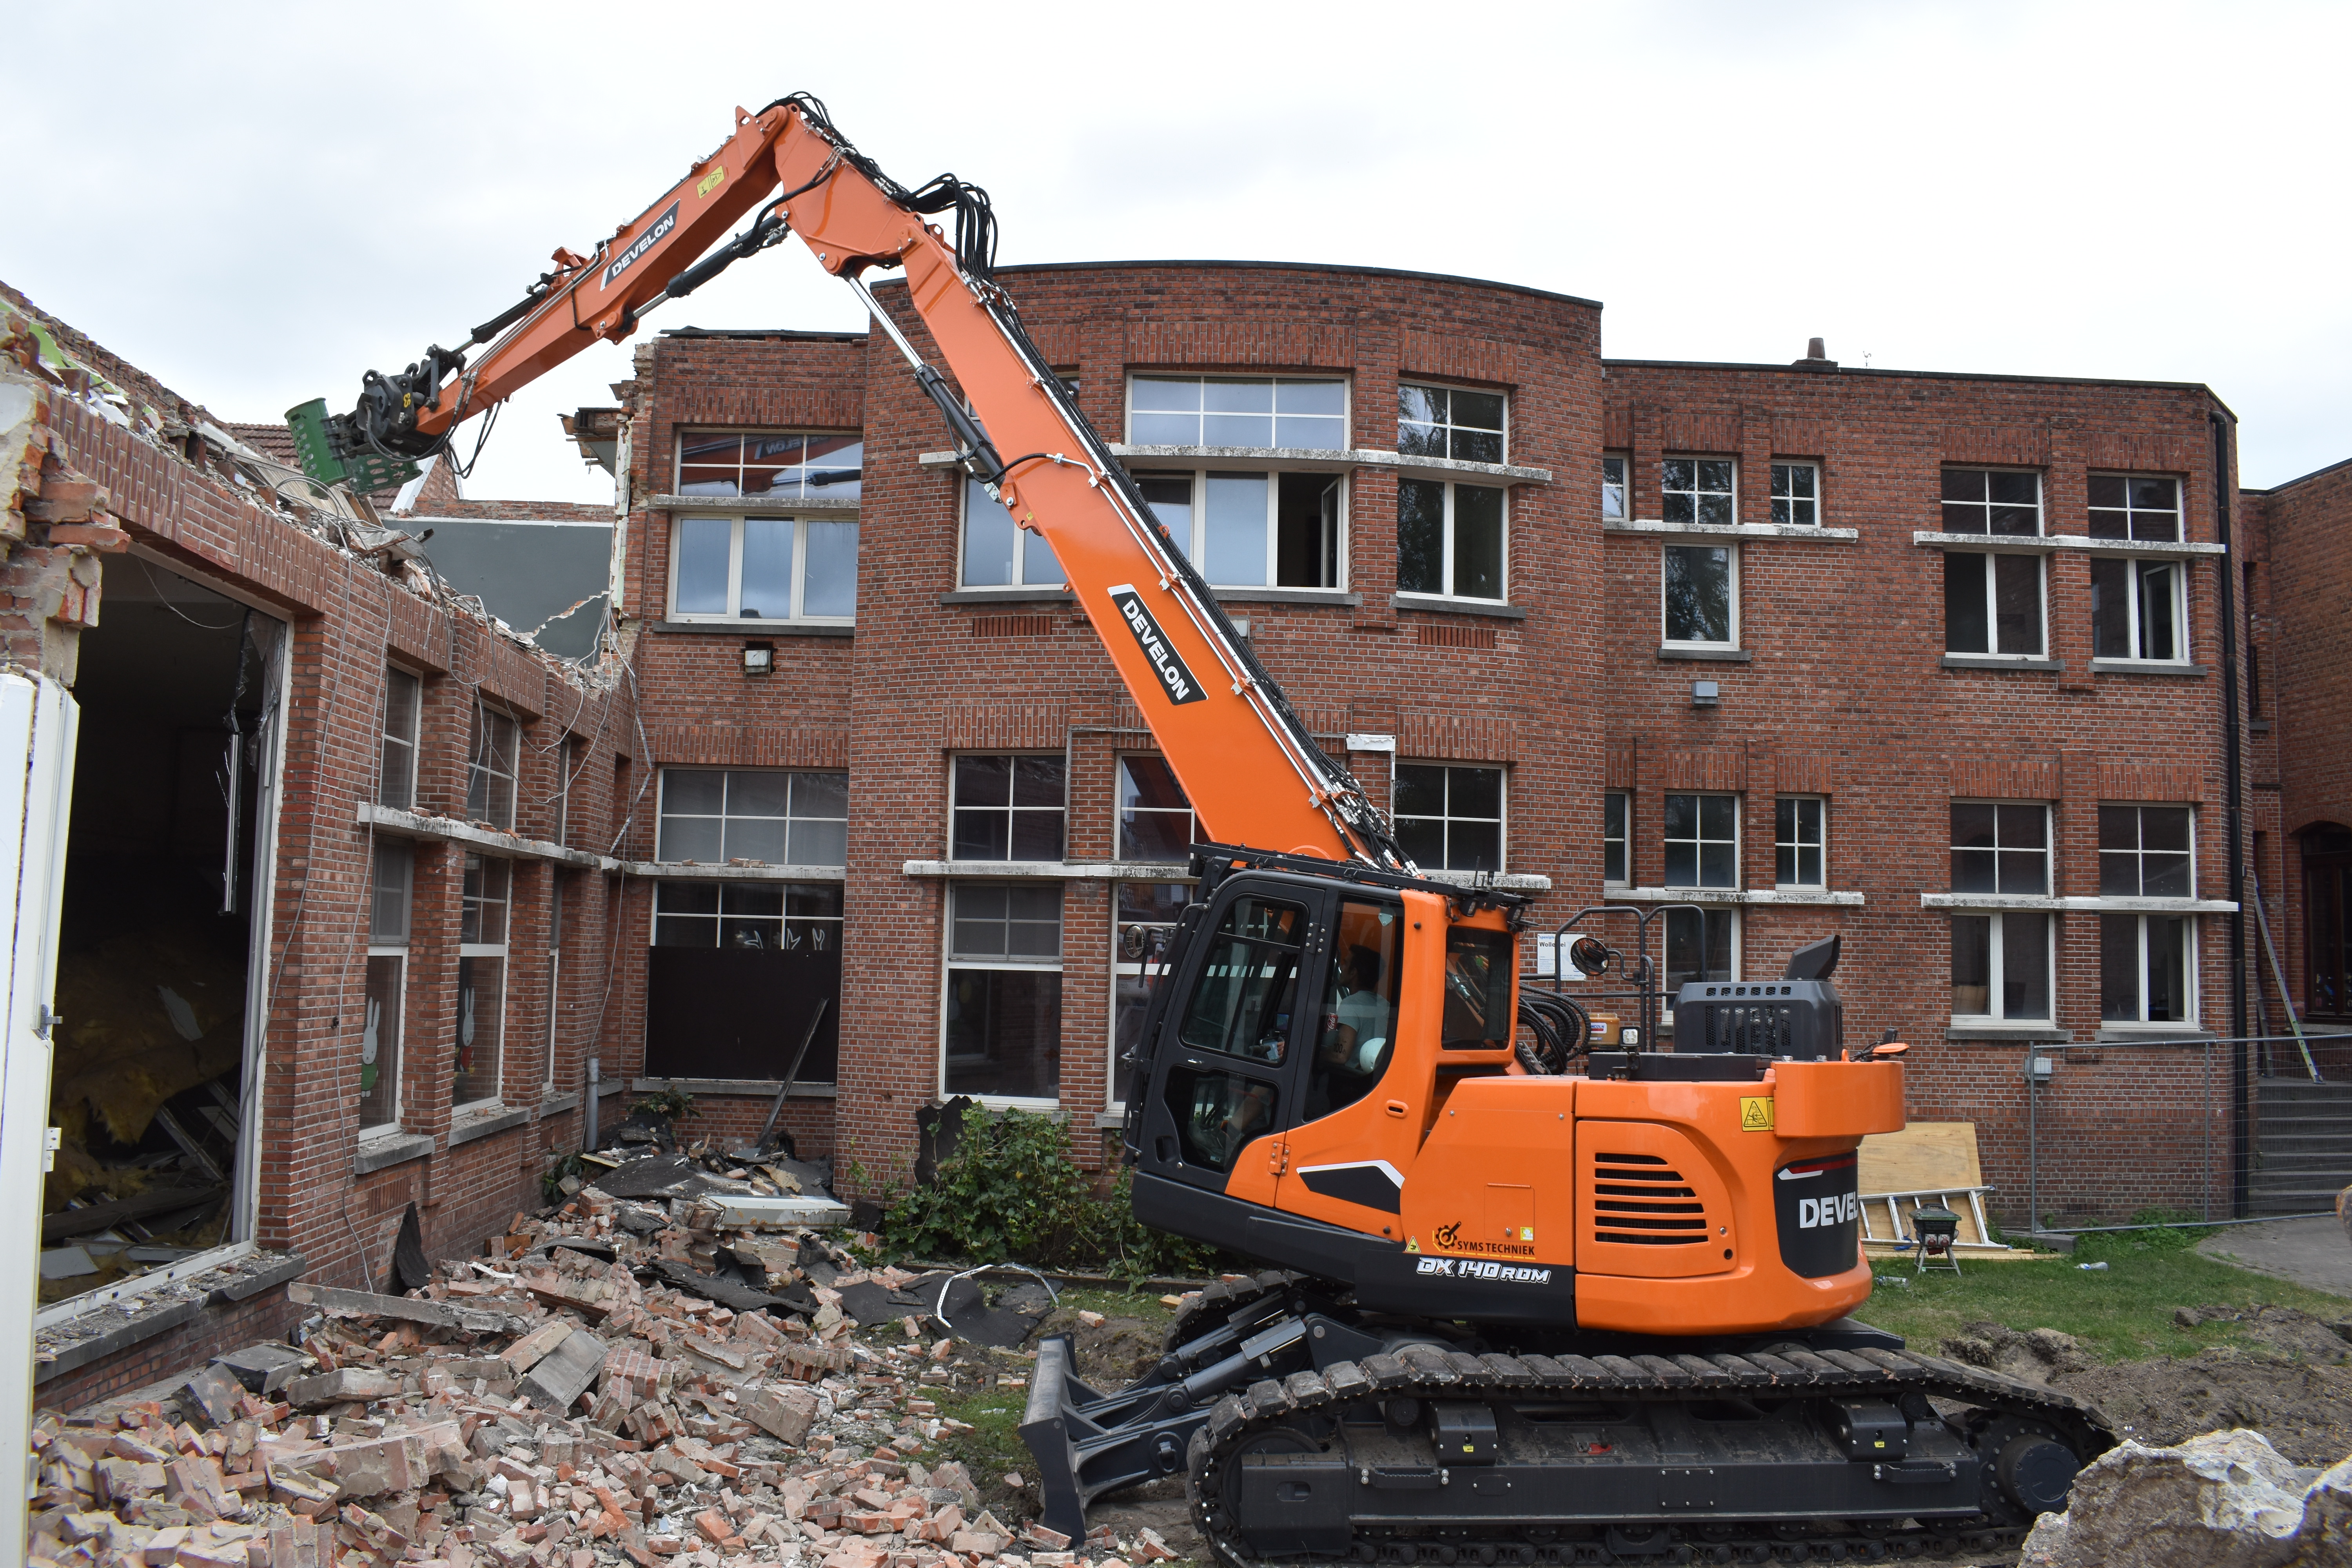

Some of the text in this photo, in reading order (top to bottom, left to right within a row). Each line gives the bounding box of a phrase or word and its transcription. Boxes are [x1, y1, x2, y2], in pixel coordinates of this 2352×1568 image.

[612, 215, 674, 277] DEVELON
[1123, 599, 1190, 700] DEVELON
[1457, 1241, 1535, 1255] SYMS TECHNIEK
